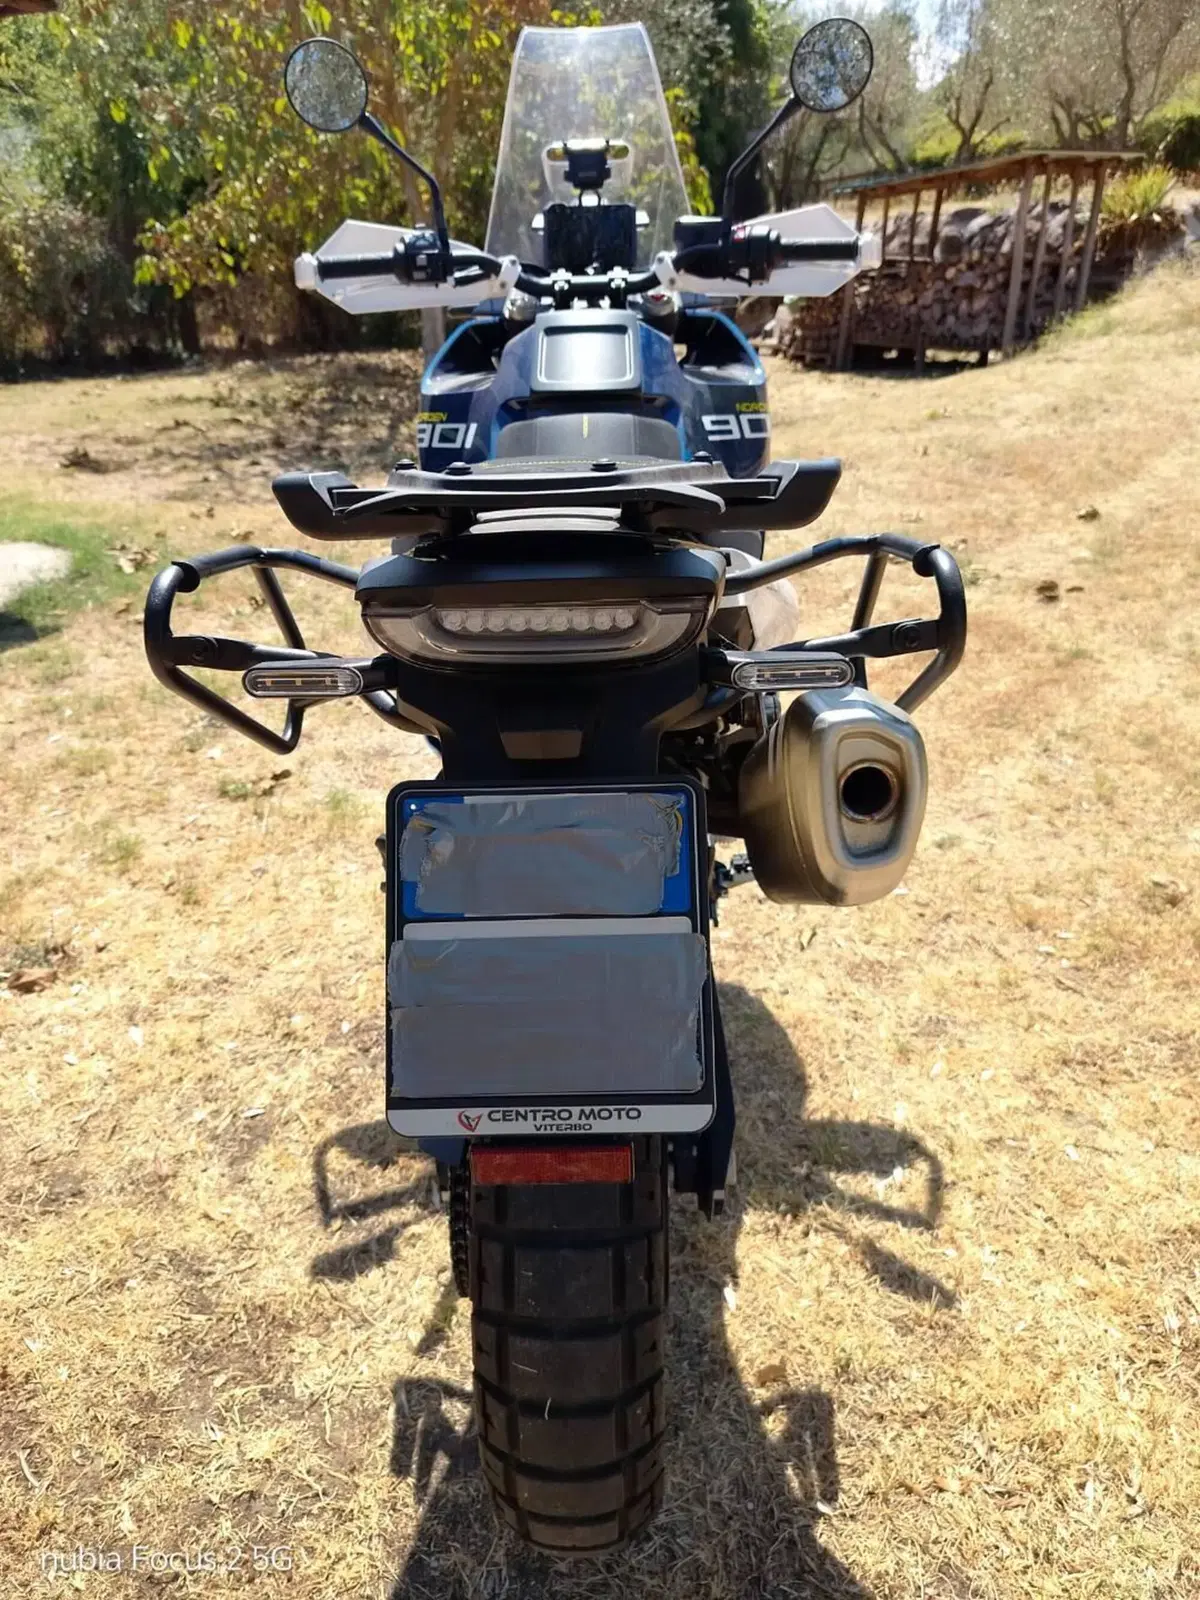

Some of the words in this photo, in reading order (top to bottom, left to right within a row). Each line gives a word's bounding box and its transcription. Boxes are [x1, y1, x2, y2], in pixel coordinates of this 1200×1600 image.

[735, 402, 767, 412] NORD
[701, 413, 771, 441] 90
[487, 1108, 573, 1122] CENTRO
[578, 1107, 642, 1121] MOTO
[533, 1123, 593, 1132] VITERBO
